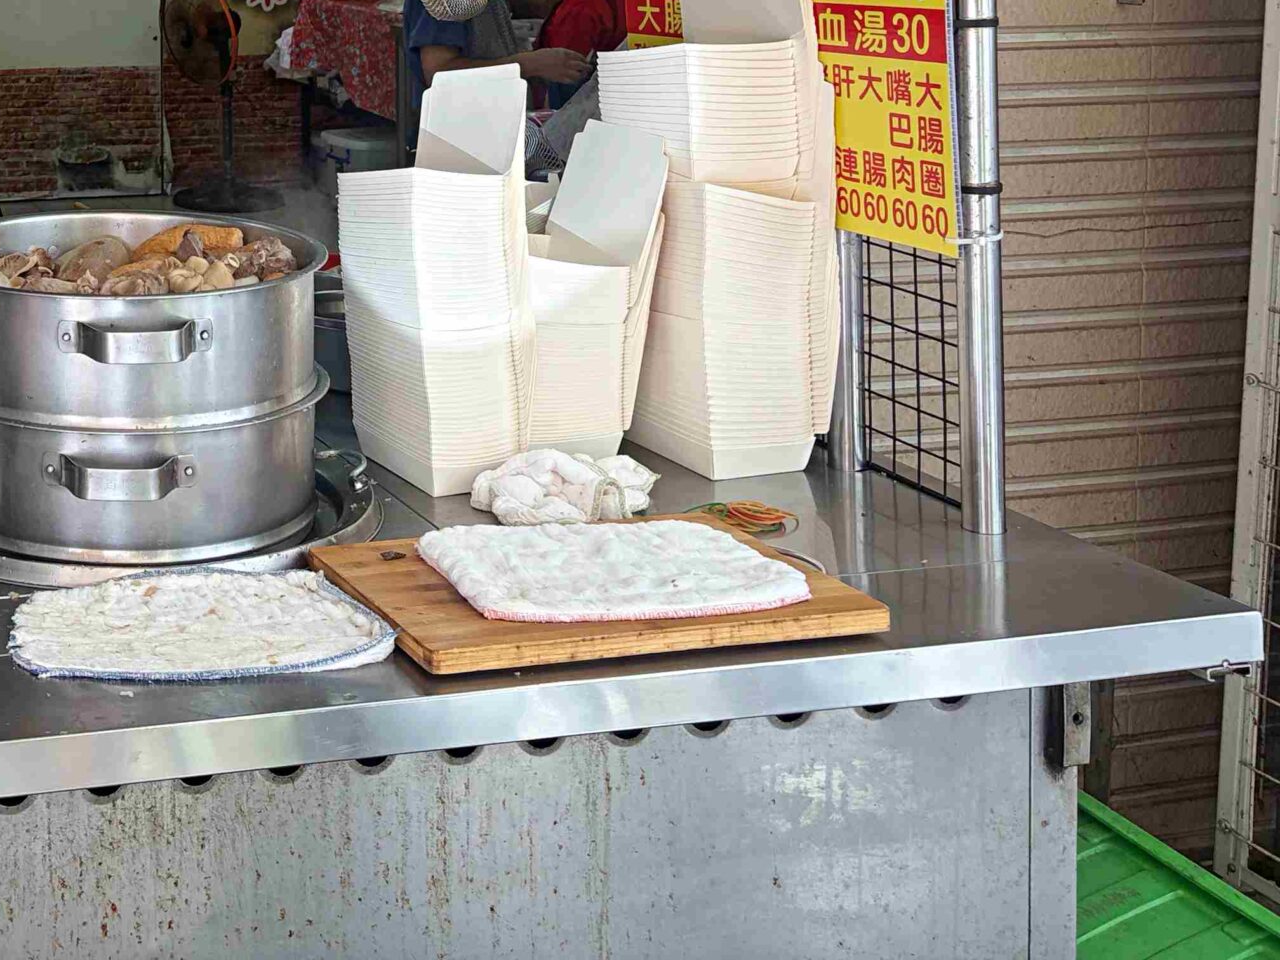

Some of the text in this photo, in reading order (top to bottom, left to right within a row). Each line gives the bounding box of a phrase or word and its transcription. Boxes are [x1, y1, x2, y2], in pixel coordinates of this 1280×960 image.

[915, 73, 949, 238] 大腸圈 60
[864, 191, 888, 224] 60
[893, 198, 918, 231] 60
